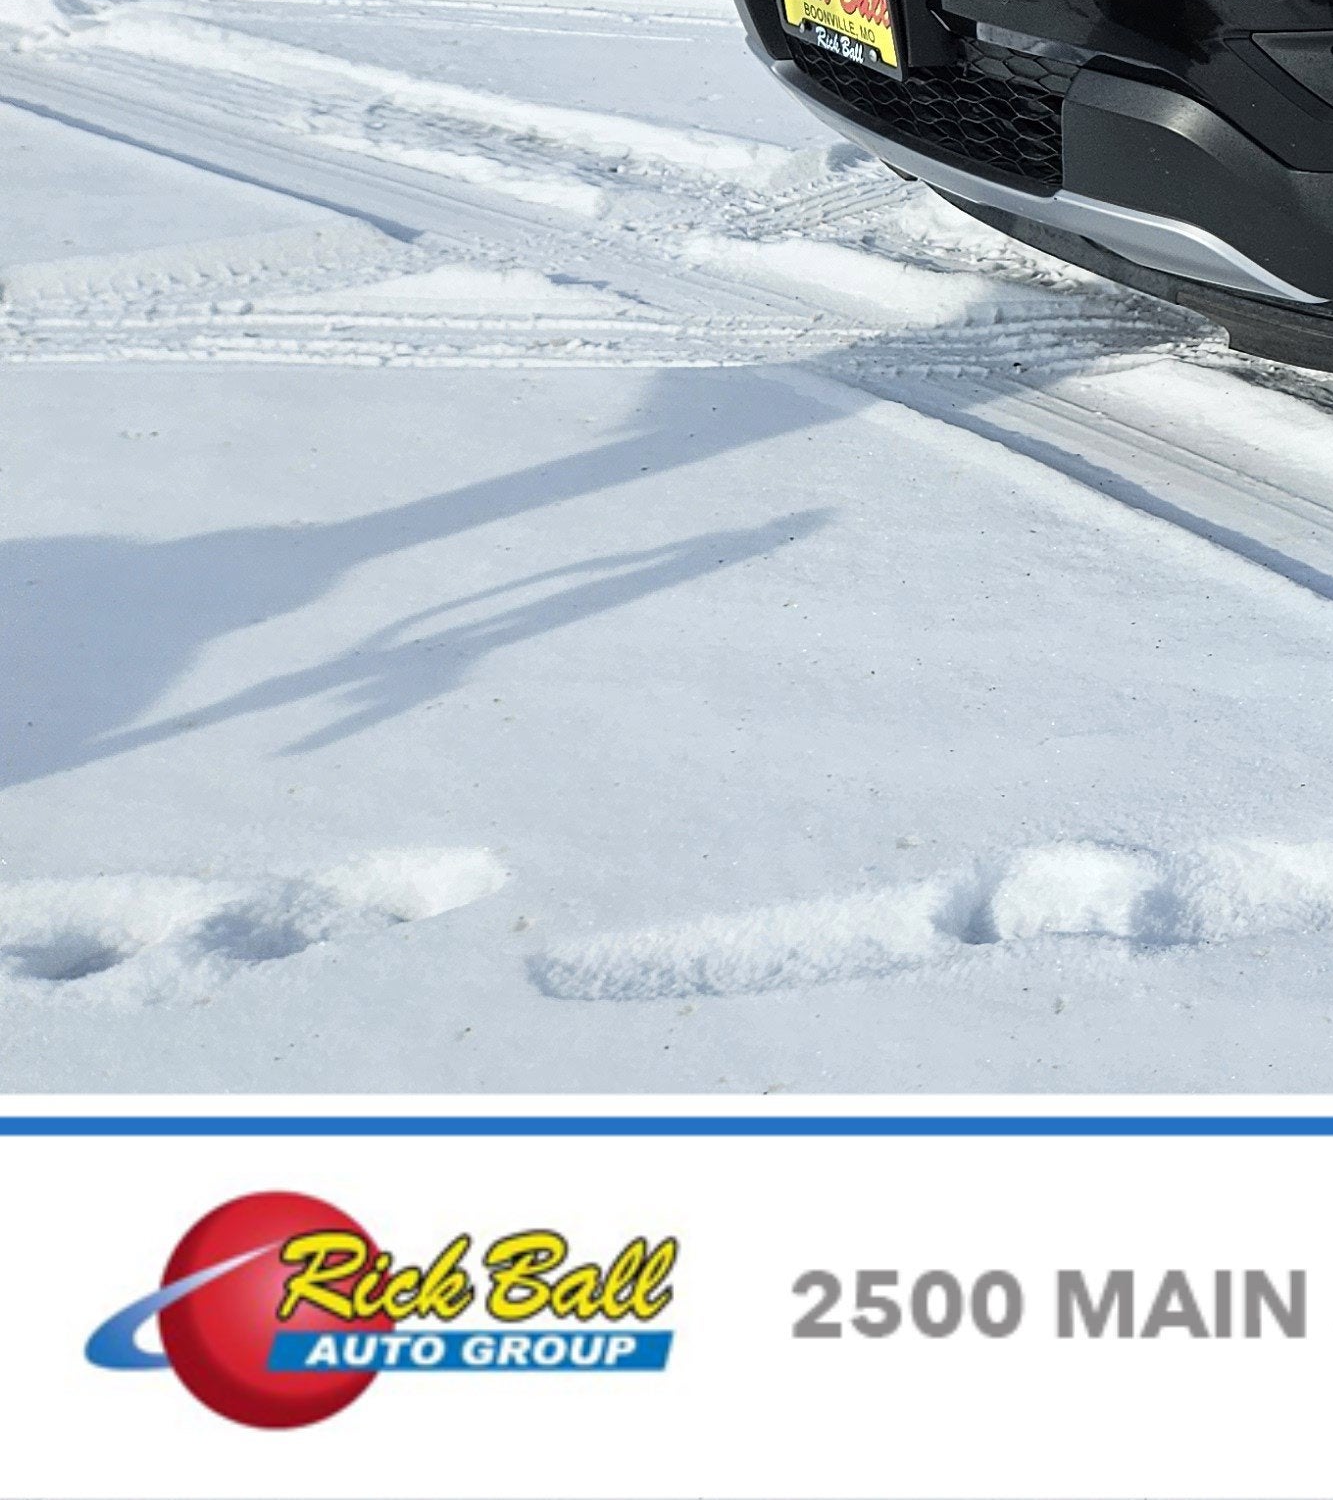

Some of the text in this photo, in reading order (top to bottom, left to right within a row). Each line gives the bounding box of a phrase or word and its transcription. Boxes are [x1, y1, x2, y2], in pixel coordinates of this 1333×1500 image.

[803, 2, 876, 43] BOONVILLE, MO
[816, 26, 866, 64] Rick Ball
